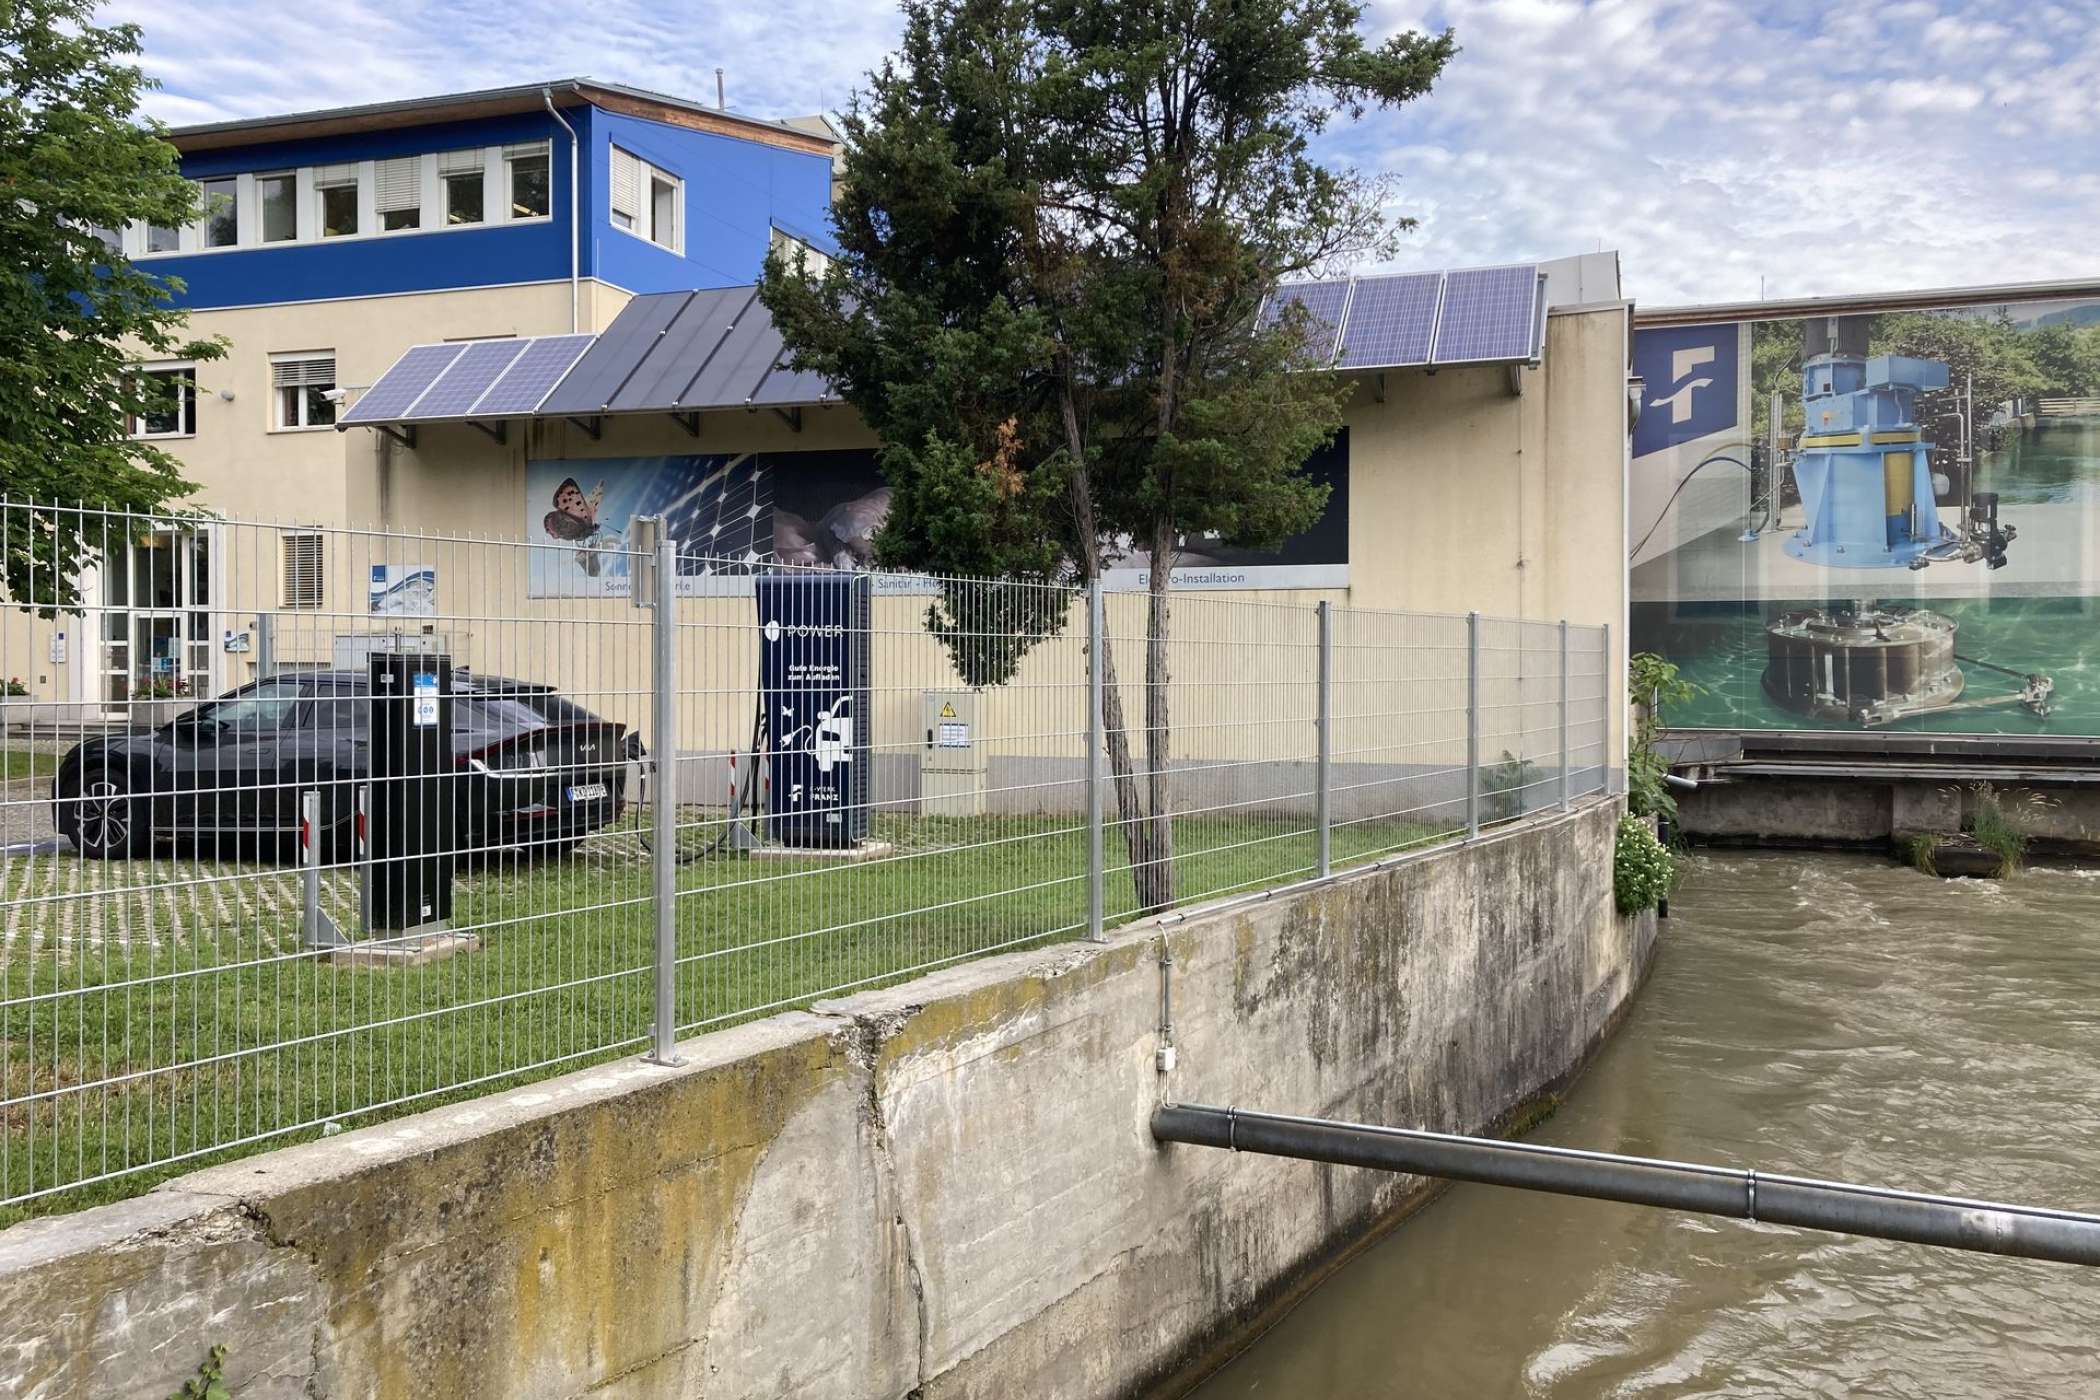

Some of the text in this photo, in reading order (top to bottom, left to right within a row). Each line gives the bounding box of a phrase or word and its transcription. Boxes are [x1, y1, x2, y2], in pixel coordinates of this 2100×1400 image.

[1139, 573, 1245, 584] Elo-Installation
[787, 624, 843, 638] POWER
[809, 664, 839, 673] Energie
[805, 673, 840, 681] Aufladen
[810, 793, 839, 801] FRANZ
